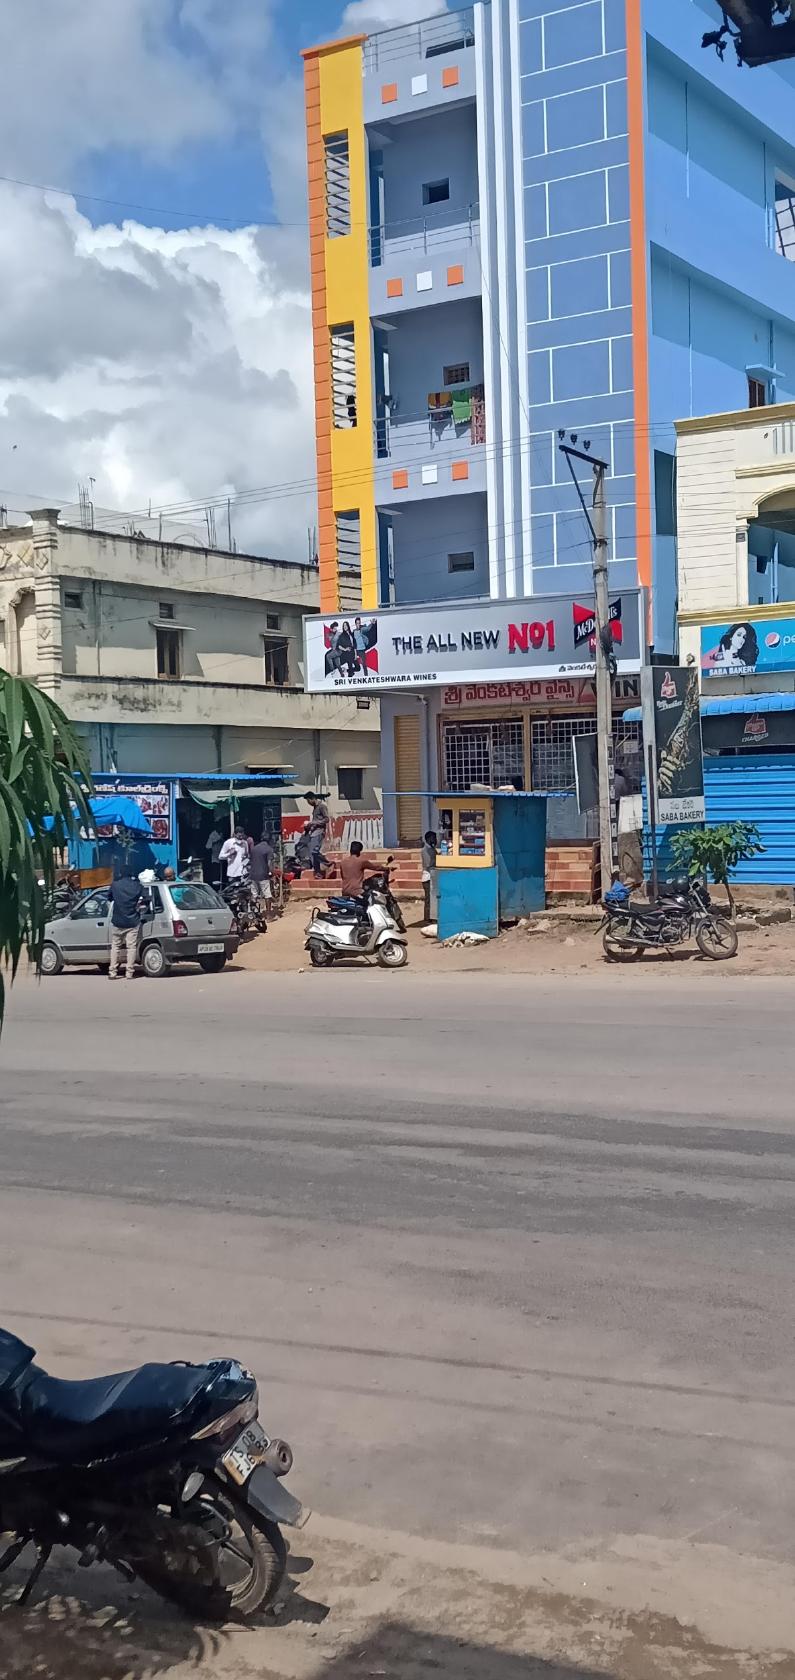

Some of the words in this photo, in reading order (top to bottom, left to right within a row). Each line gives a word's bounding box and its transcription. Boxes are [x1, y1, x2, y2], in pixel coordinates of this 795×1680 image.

[391, 635, 423, 655] THE
[426, 633, 458, 653] ALL
[461, 629, 500, 651] NEW
[708, 667, 728, 677] SABA
[728, 665, 757, 675] BAKERY
[334, 678, 346, 686] SRI
[348, 674, 412, 686] VENKATESHWARA
[413, 673, 437, 682] WINES
[444, 685, 462, 704] శ్రీ
[660, 812, 679, 822] SABA
[679, 810, 704, 821] BAKERY
[242, 1430, 256, 1447] 08
